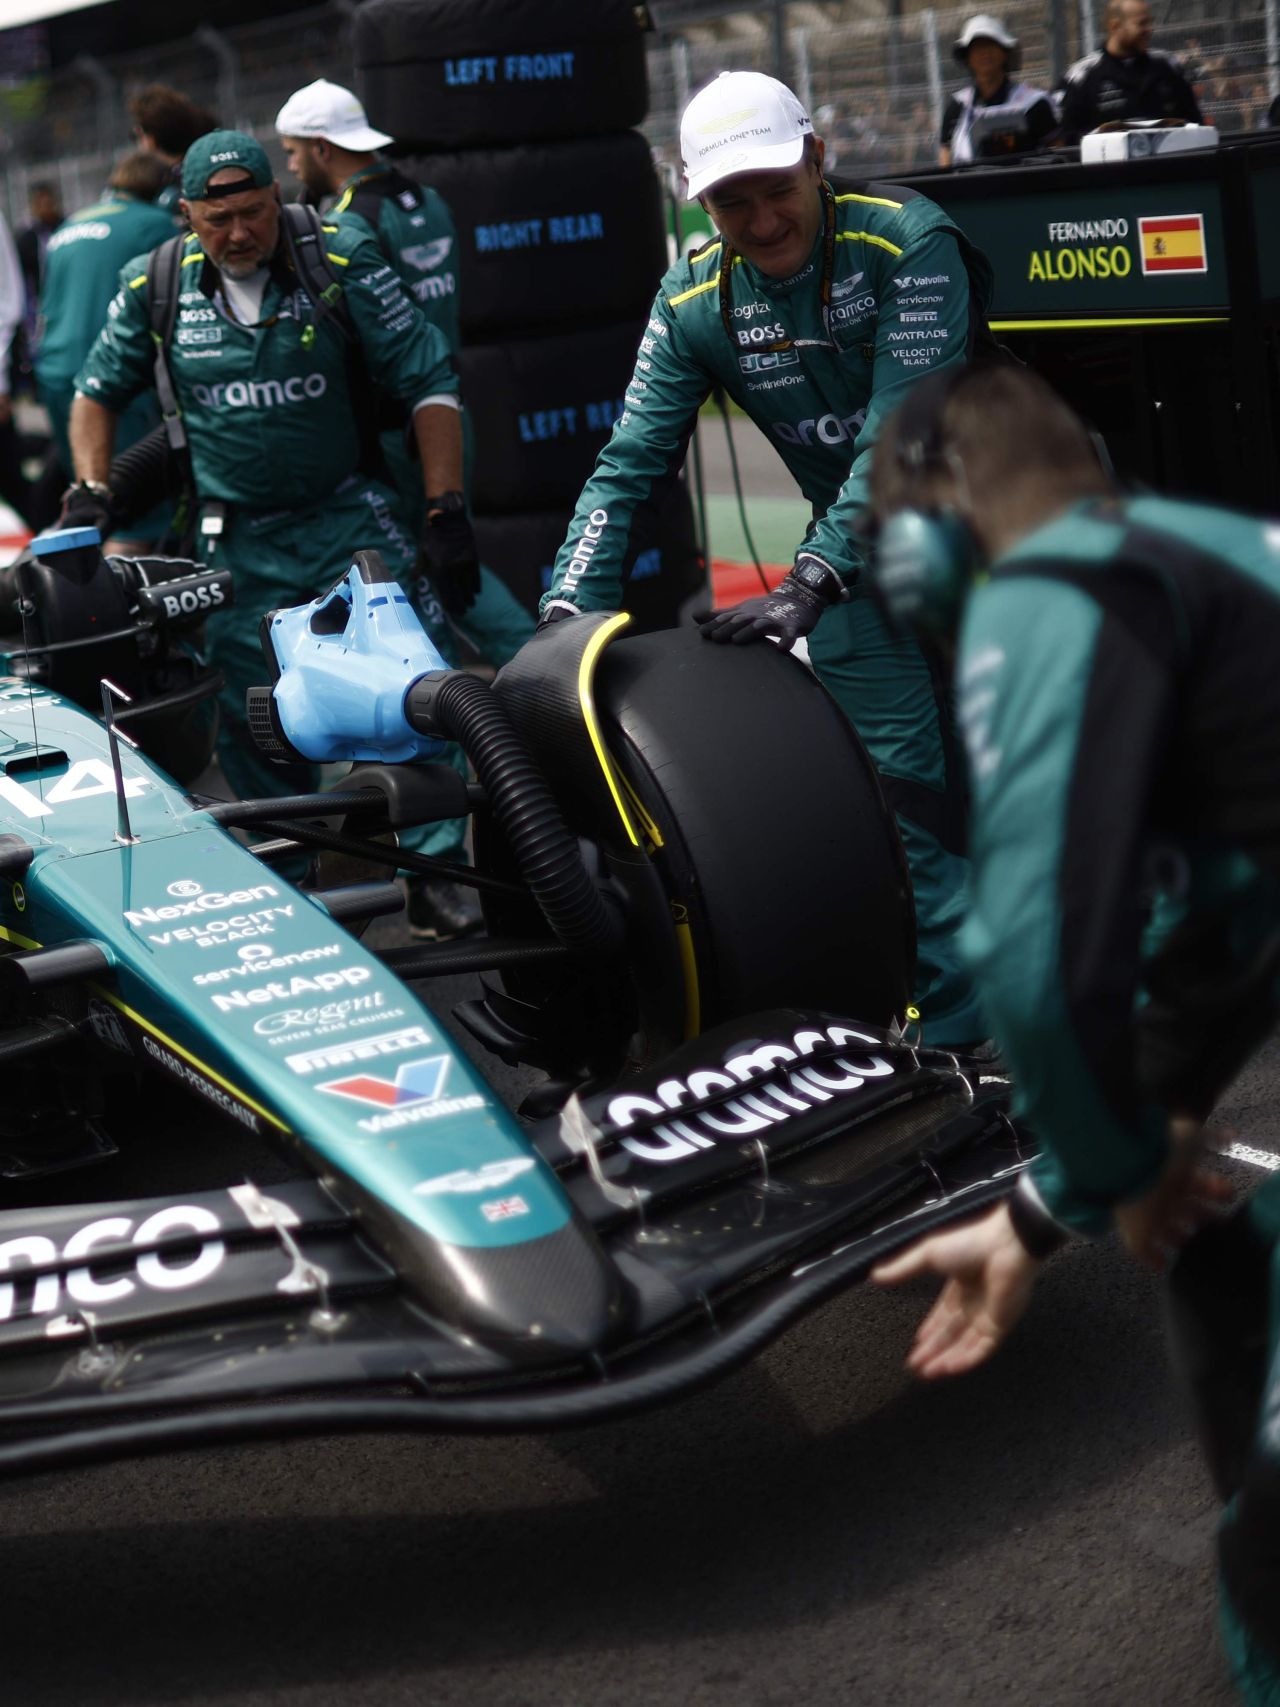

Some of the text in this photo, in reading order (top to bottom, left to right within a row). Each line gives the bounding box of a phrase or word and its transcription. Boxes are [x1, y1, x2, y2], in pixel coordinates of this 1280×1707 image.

[445, 52, 575, 85] LEFT FRONT
[699, 139, 728, 157] FORMULA
[750, 127, 772, 137] TEAM
[475, 212, 605, 251] RIGHT REAR
[1048, 217, 1129, 242] FERNANDO
[1028, 245, 1132, 283] ALONSO
[180, 308, 217, 323] BOSS
[829, 296, 875, 323] ramco
[896, 294, 945, 305] servicenow
[900, 311, 938, 322] PIRELLI
[737, 322, 786, 347] BOSS
[887, 329, 949, 341] AVATRADE
[891, 347, 942, 358] VELOCITY
[903, 357, 931, 366] BLACK
[192, 372, 327, 409] aramco
[747, 373, 806, 391] SentinelOne
[518, 405, 578, 443] LEFT
[560, 508, 609, 592] ramco
[163, 582, 225, 619] BOSS
[123, 884, 279, 927] NexGen
[148, 904, 295, 945] VELOCITY
[195, 923, 276, 948] BLACK
[192, 943, 341, 986] servicenow
[211, 966, 371, 1013] NetApp
[253, 990, 385, 1035] Regent
[267, 1007, 406, 1046] SEVEN SEAS CRUISES
[284, 1024, 433, 1076] PIRELLI
[142, 1035, 261, 1134] GIRARD-PERREGAUX
[607, 1025, 895, 1162] aramco
[356, 1093, 487, 1134] Valvoline
